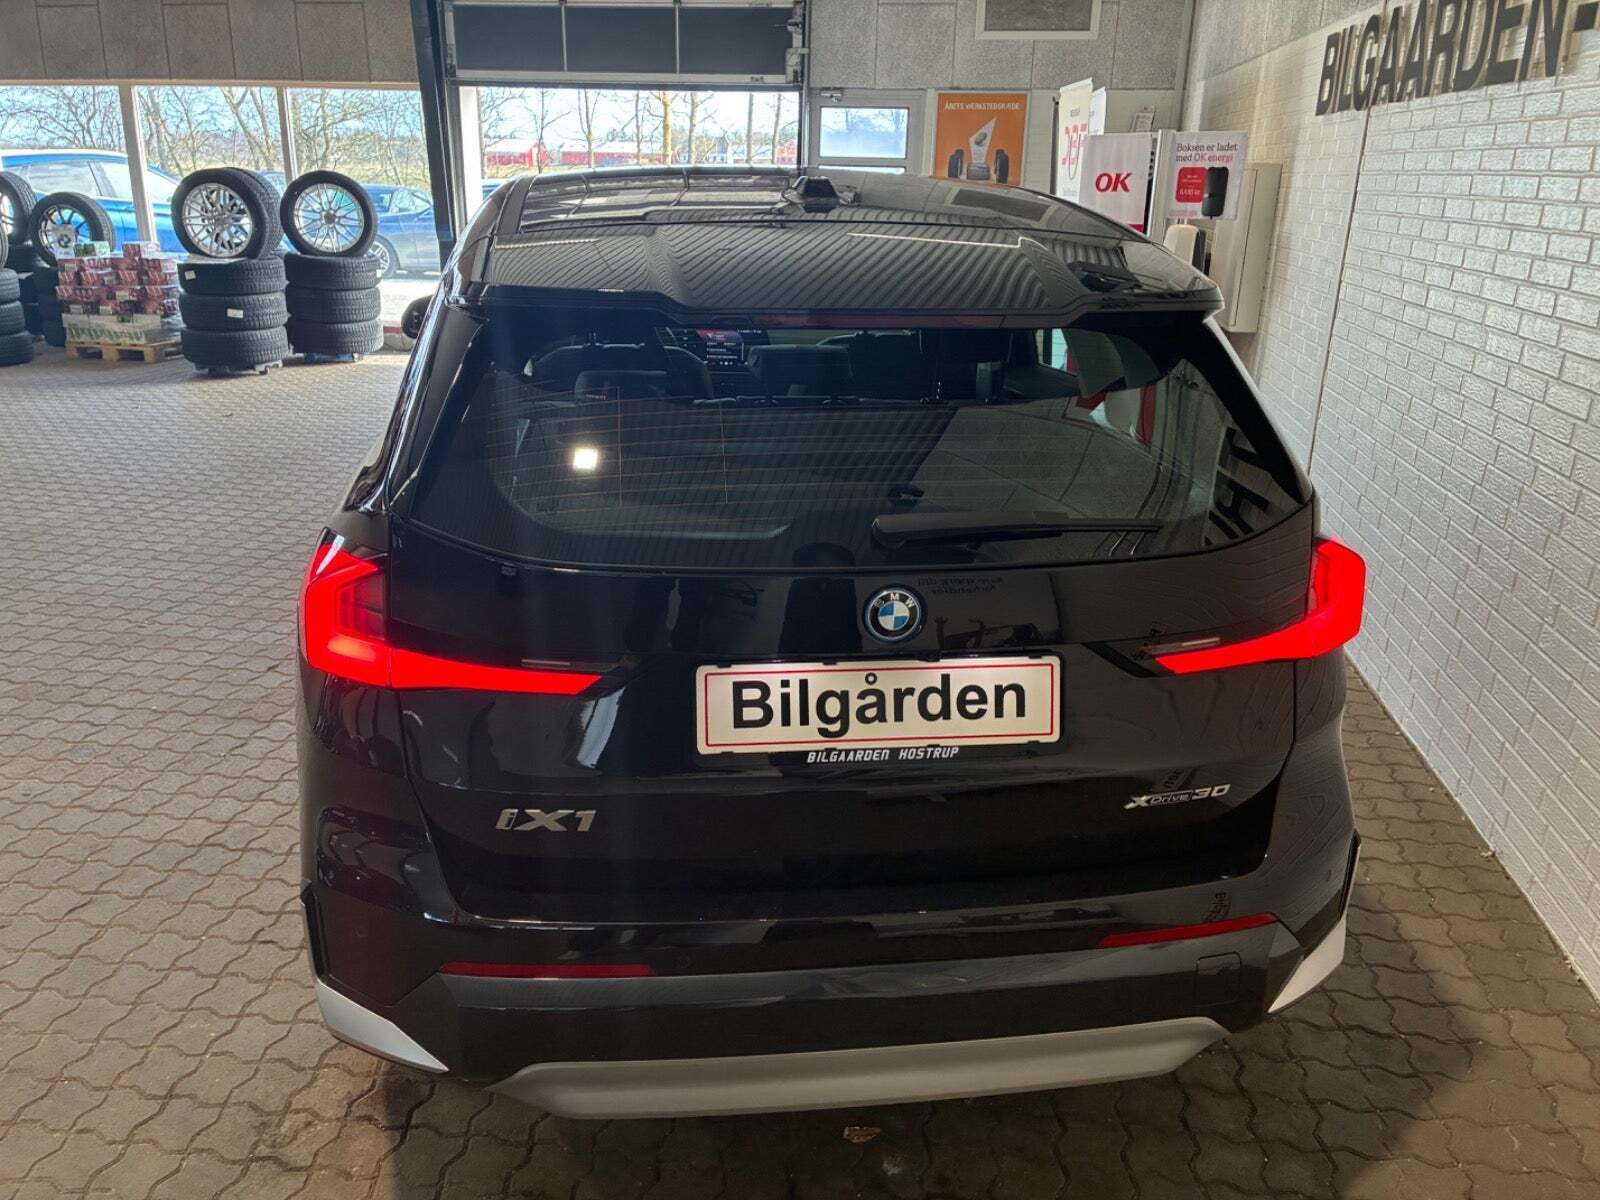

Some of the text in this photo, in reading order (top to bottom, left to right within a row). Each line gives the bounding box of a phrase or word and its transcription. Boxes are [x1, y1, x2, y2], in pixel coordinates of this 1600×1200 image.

[1177, 143, 1205, 152] Boksen
[1216, 142, 1238, 151] ladet
[1176, 153, 1233, 164] med OK energi
[1095, 172, 1132, 193] OK
[732, 672, 1026, 738] Bilgården
[806, 746, 959, 764] BILGAARDEN HOSTRUP
[496, 808, 597, 832] iX1
